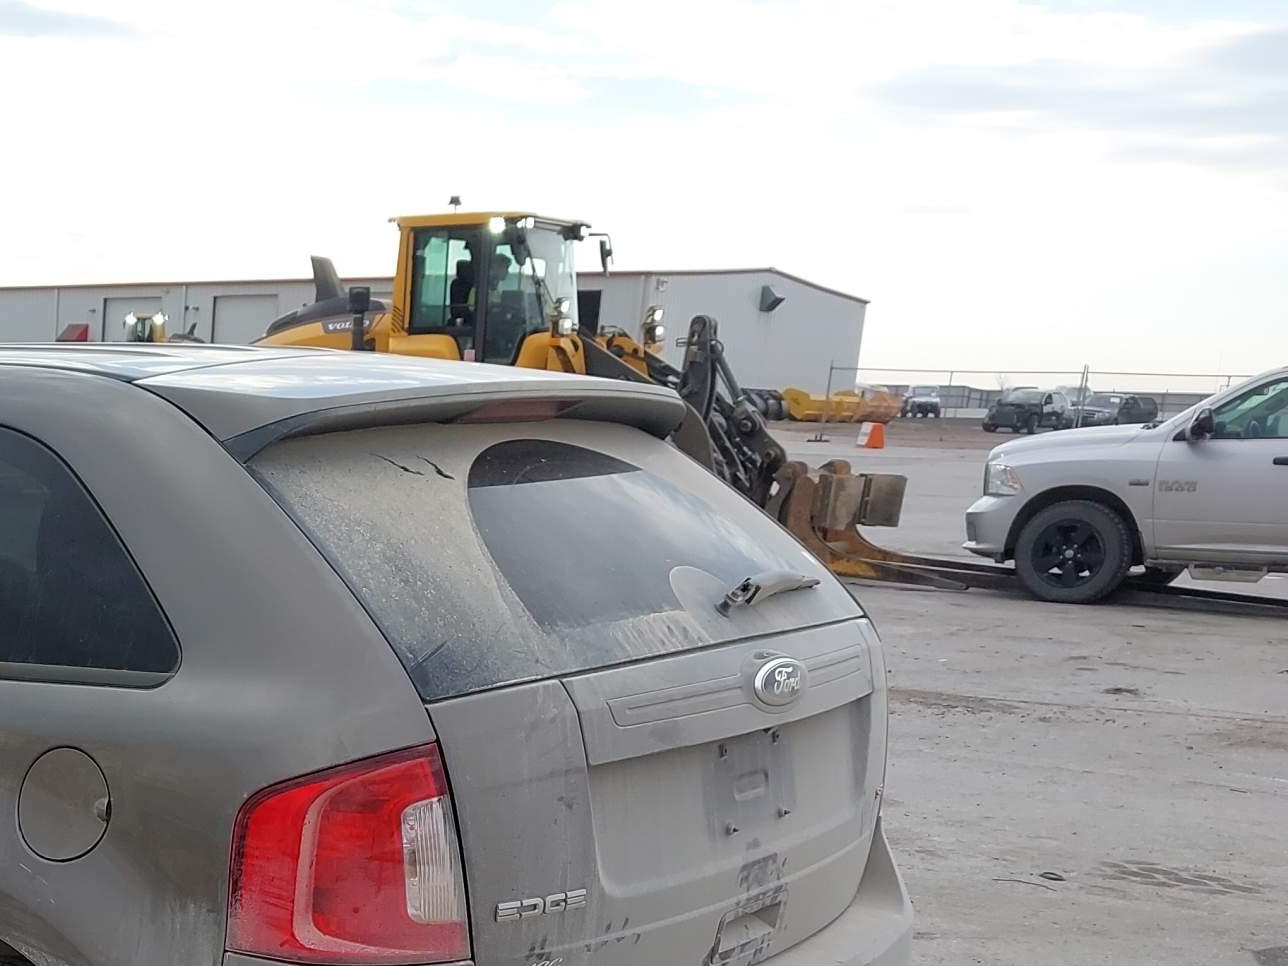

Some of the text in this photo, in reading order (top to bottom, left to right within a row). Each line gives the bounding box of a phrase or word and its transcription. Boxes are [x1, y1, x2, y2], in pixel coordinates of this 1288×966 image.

[327, 319, 370, 330] VOLO
[774, 666, 800, 694] Ford
[495, 888, 587, 922] EDGE
